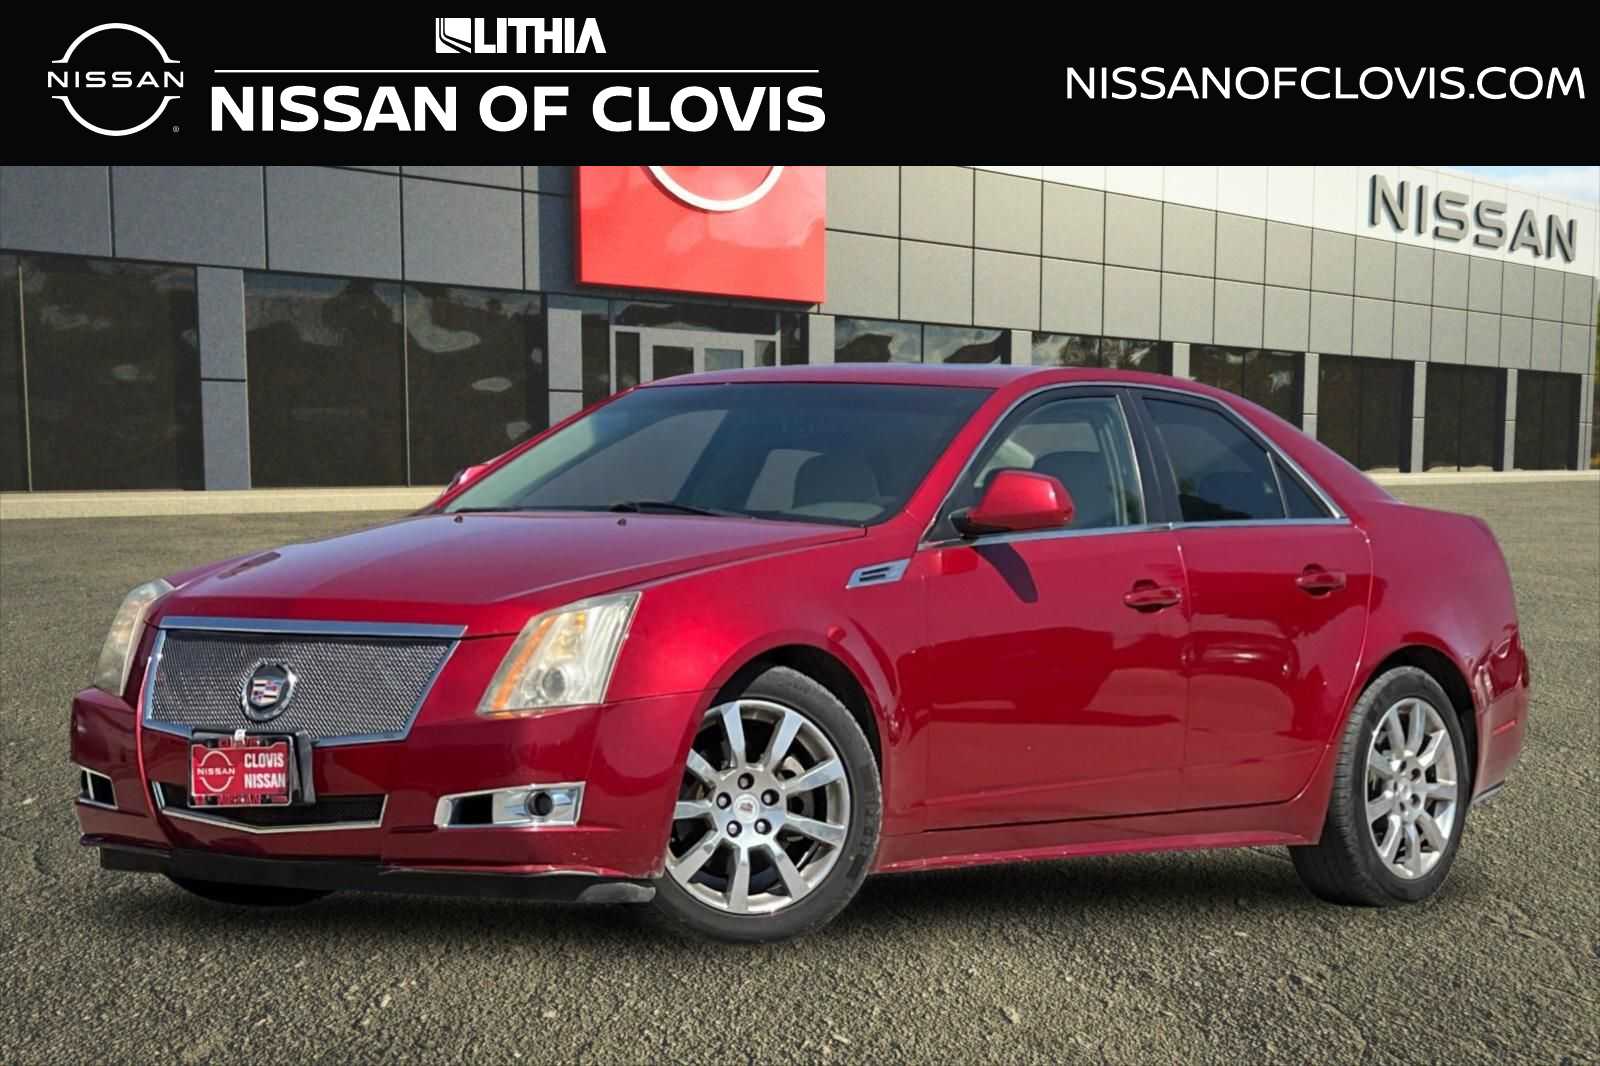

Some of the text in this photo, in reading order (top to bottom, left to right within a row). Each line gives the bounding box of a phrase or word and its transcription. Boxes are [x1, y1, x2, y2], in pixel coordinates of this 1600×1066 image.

[1369, 174, 1577, 263] NISSAN
[244, 752, 284, 768] CLOVIS
[197, 767, 235, 776] NISSAN
[244, 773, 286, 789] NISSAN
